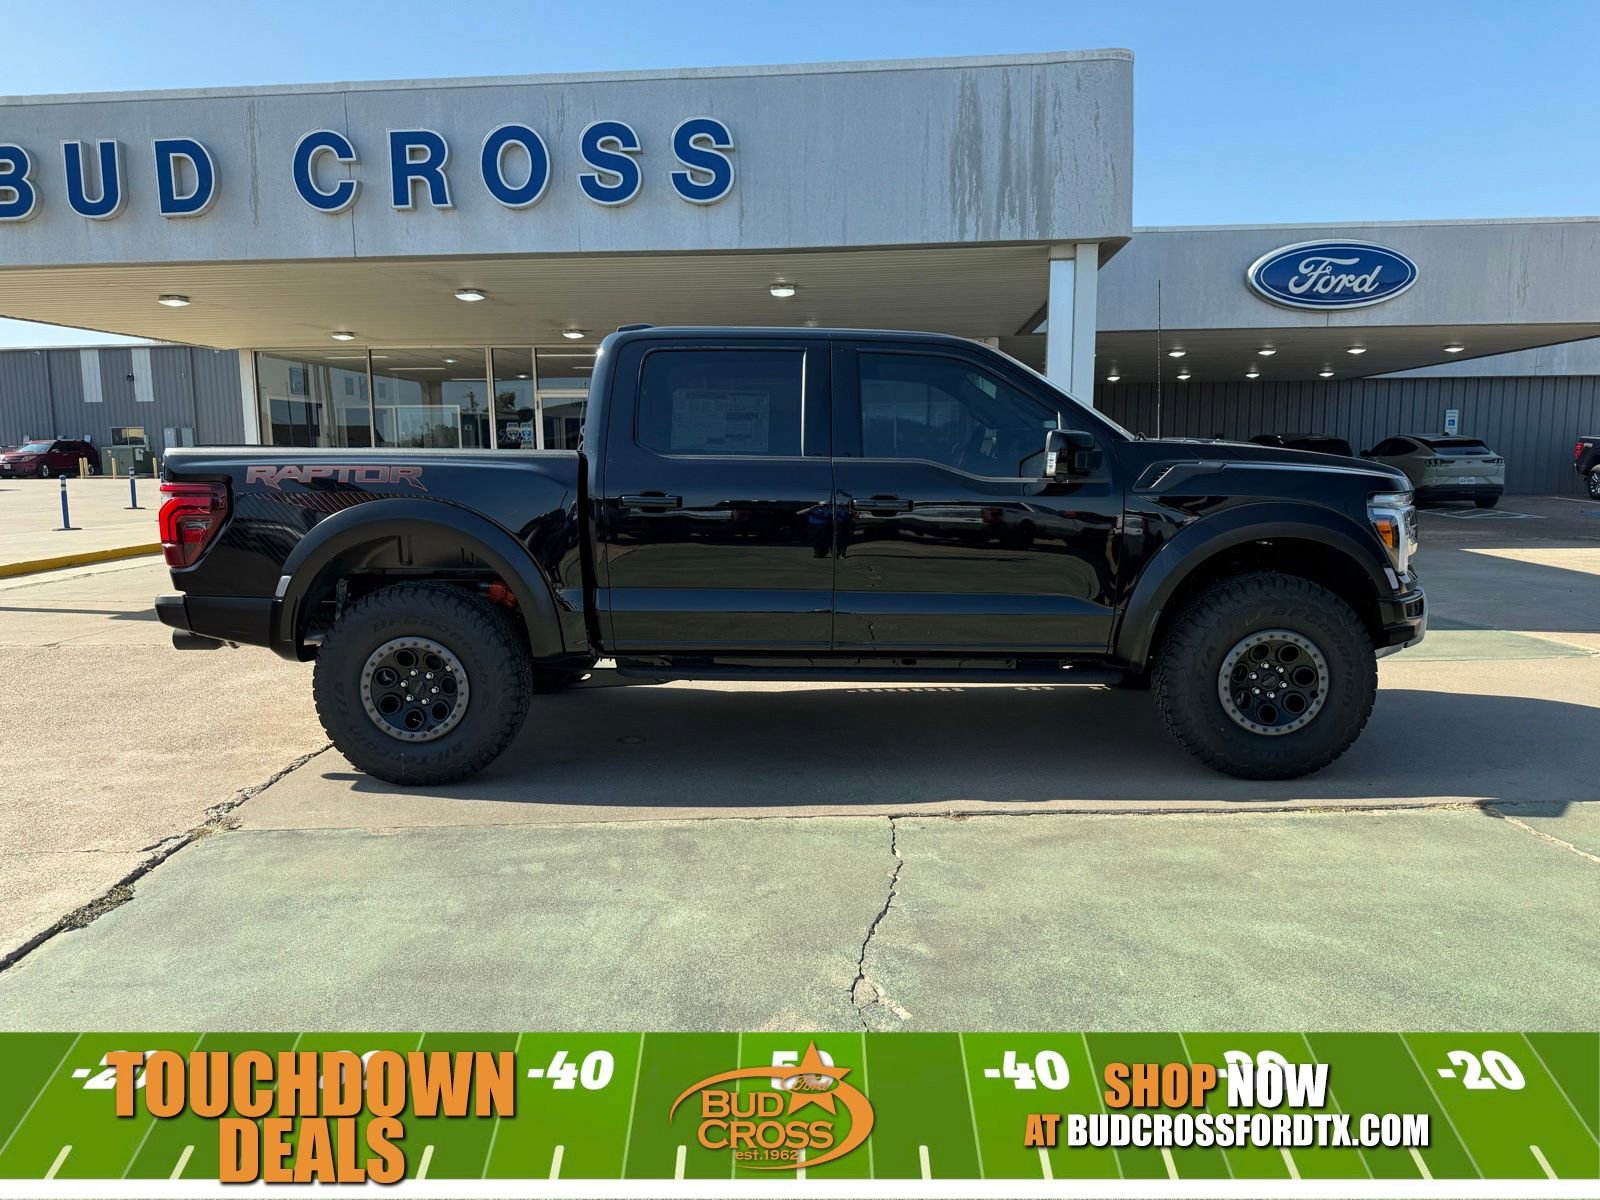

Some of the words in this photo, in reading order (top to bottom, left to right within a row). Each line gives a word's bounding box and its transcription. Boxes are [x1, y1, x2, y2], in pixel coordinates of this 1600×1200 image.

[0, 137, 220, 222] BUD
[291, 116, 736, 214] CROSS
[1288, 256, 1383, 295] Ford
[246, 465, 428, 492] RAPTOR
